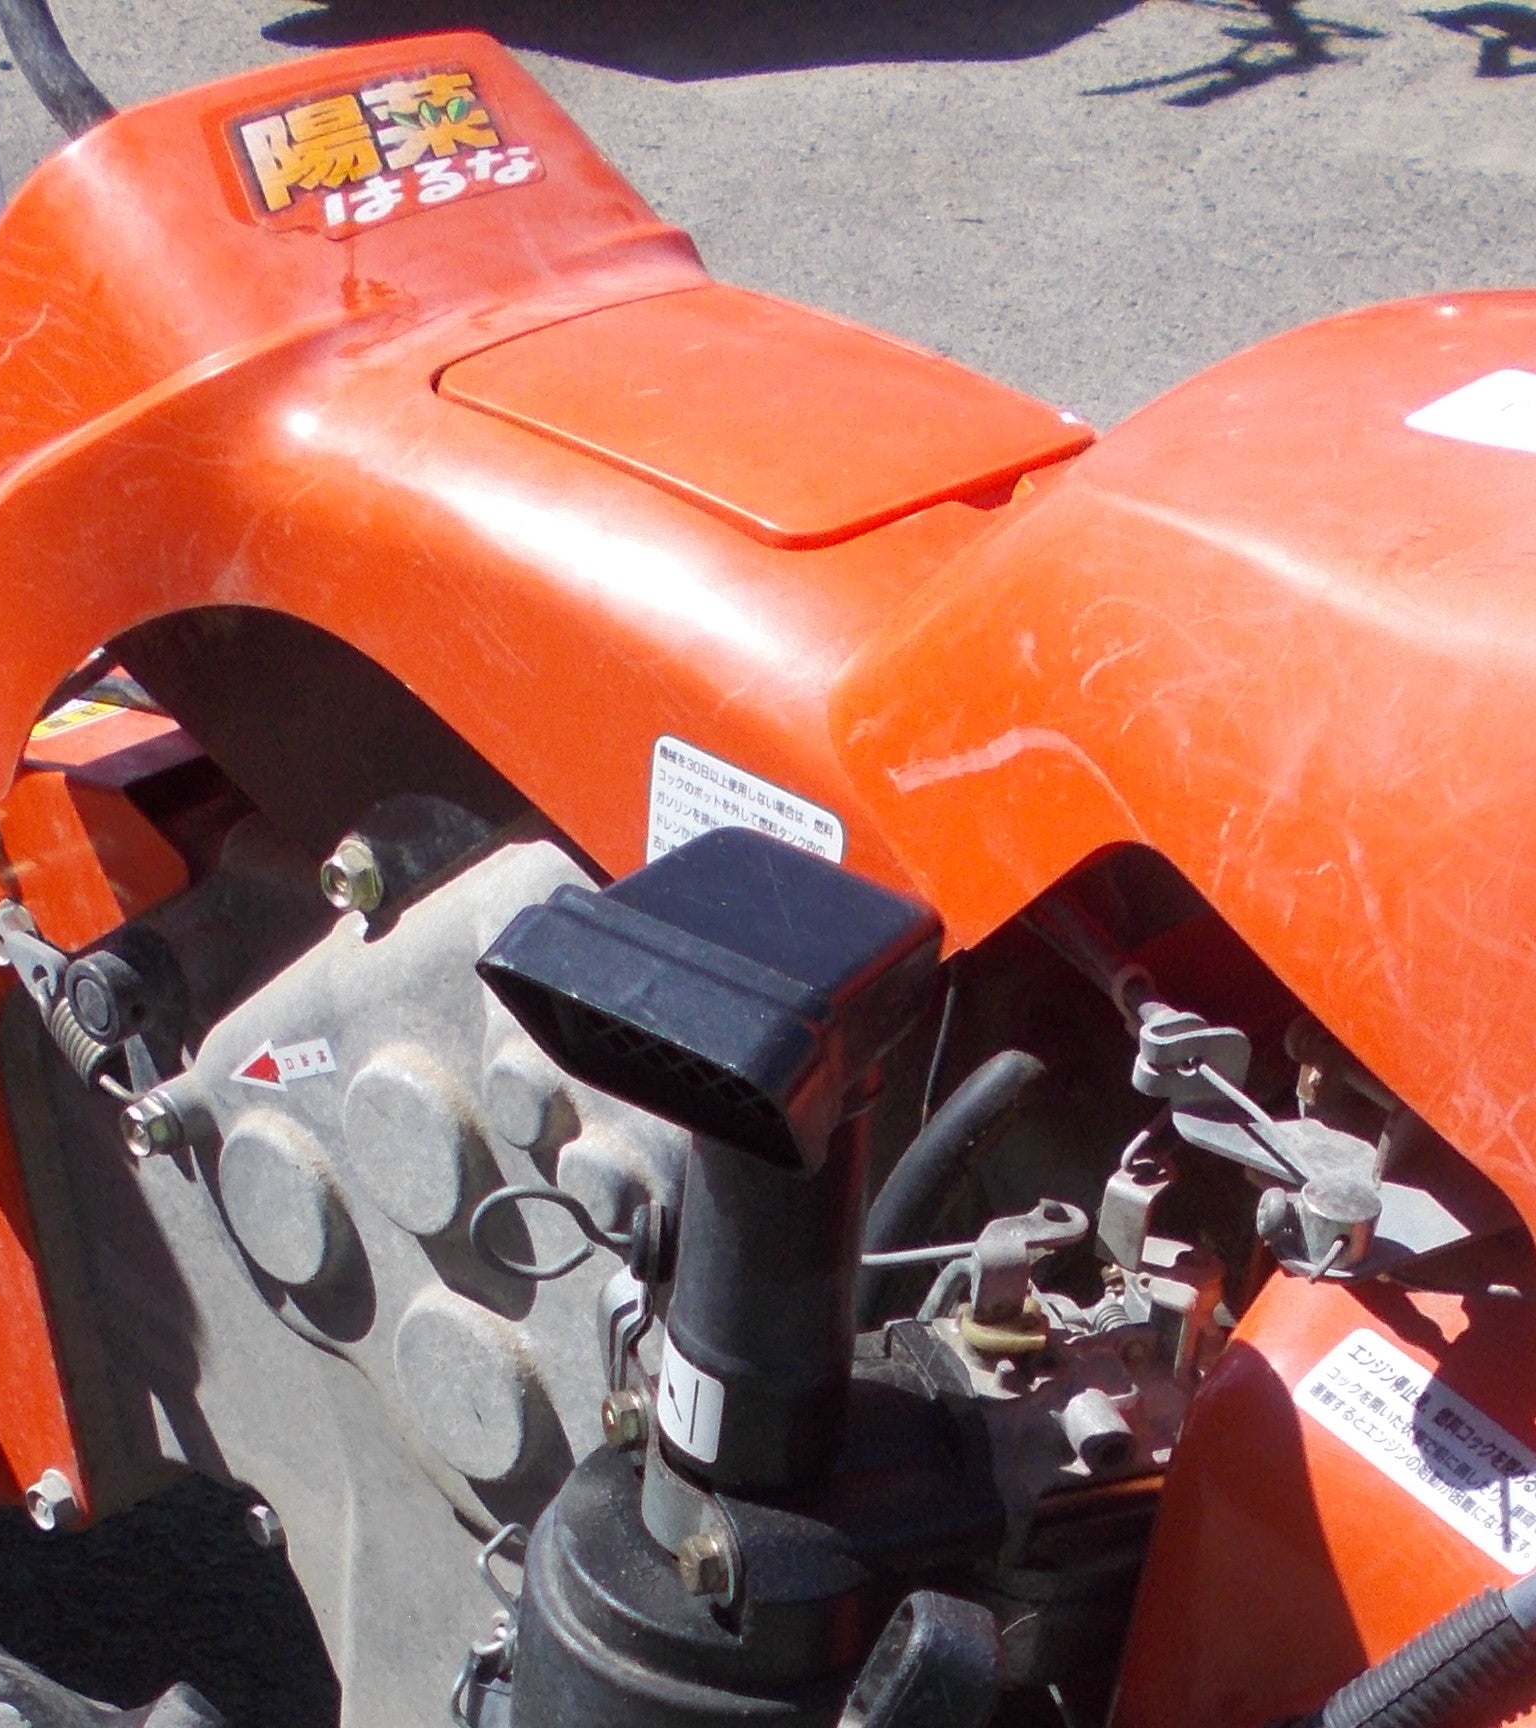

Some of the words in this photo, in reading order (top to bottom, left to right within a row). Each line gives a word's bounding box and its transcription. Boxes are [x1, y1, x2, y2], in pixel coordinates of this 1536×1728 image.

[240, 72, 500, 212] 陽菜
[323, 146, 539, 228] はるな
